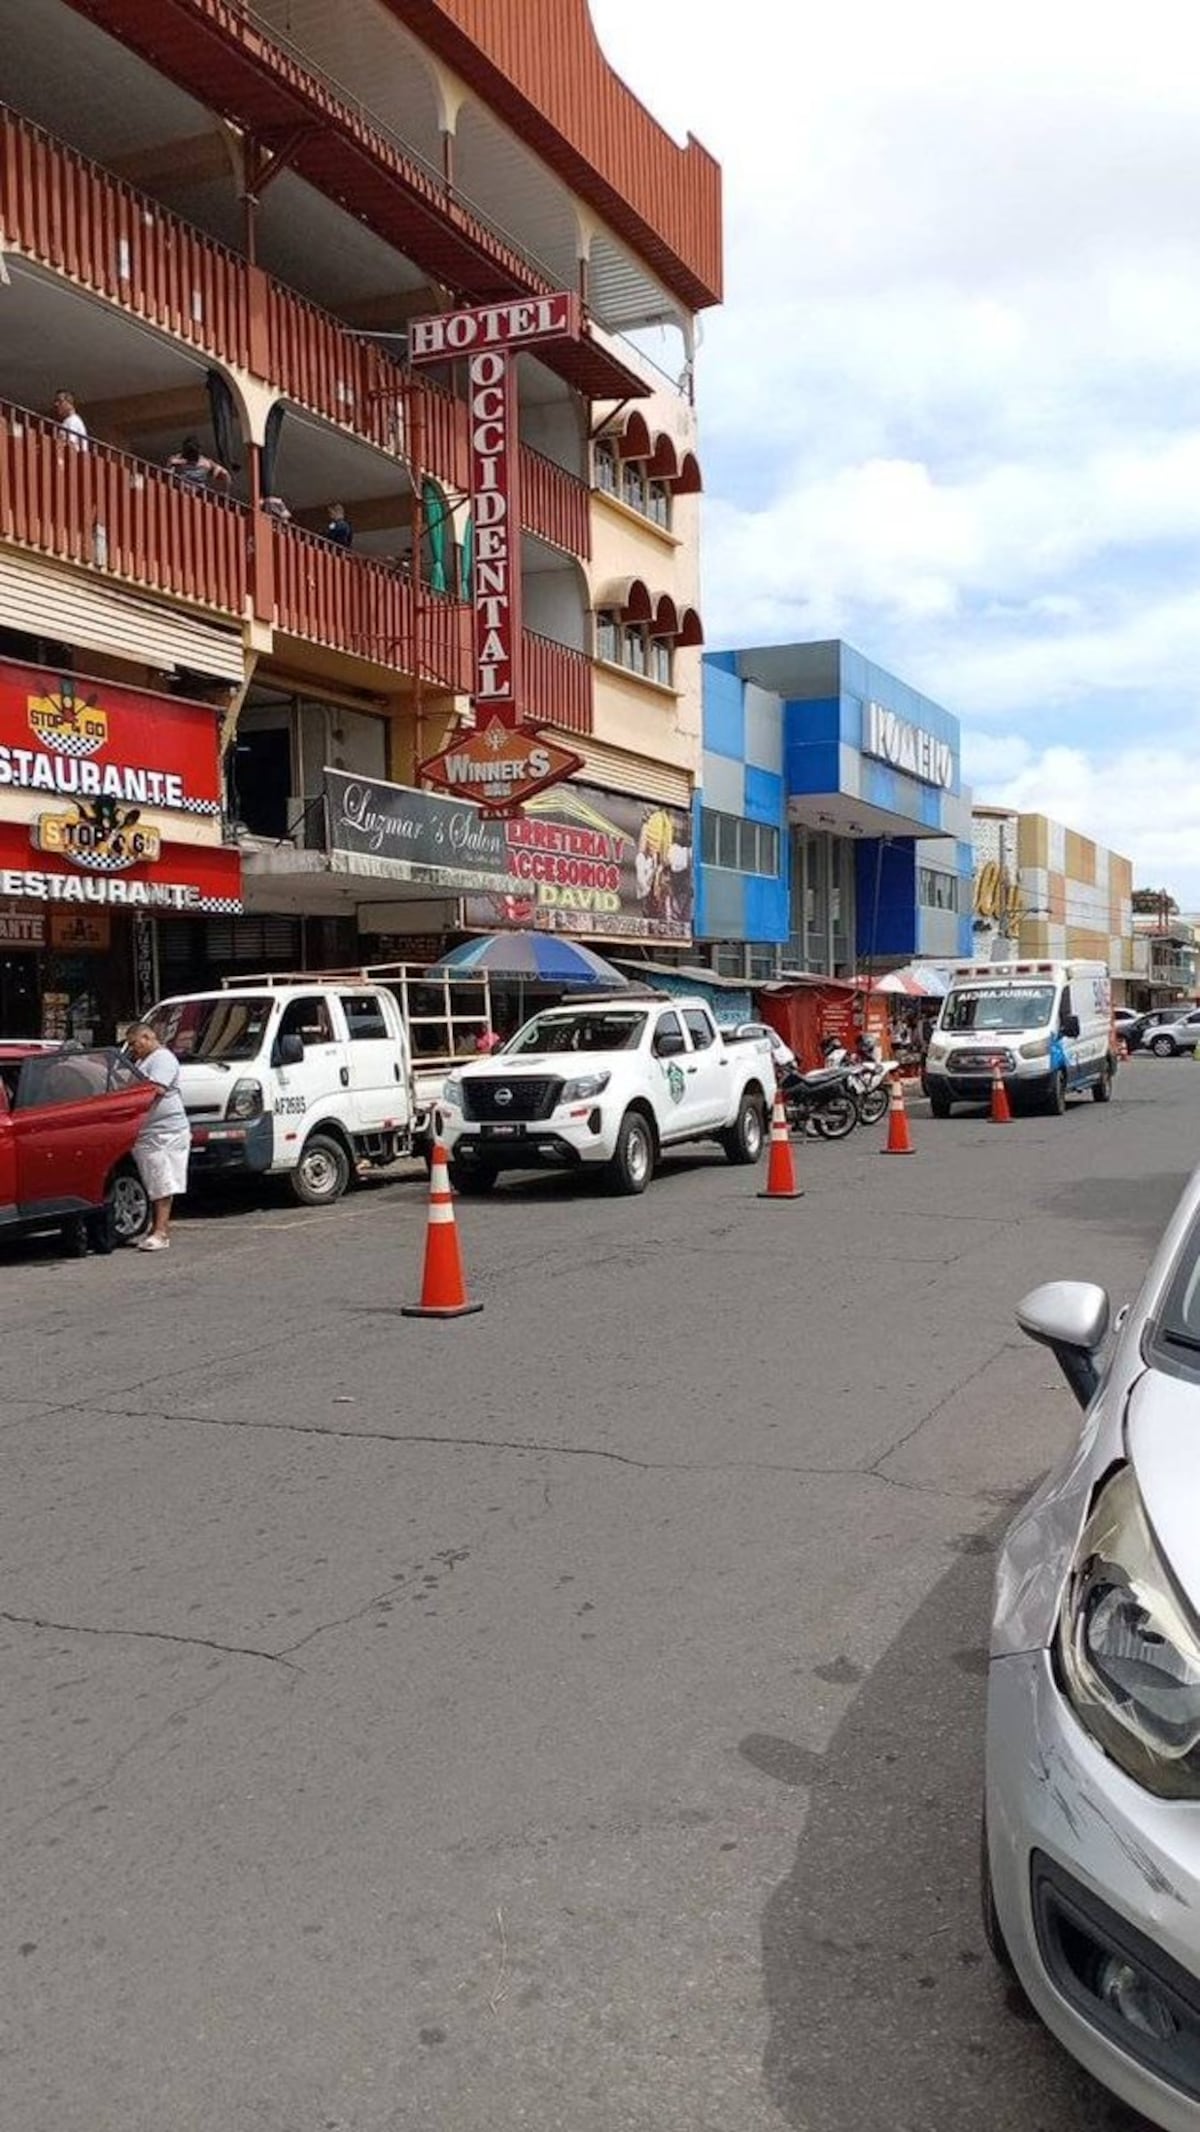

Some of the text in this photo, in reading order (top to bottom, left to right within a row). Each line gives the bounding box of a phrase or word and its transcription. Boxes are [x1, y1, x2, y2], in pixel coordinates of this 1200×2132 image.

[412, 300, 566, 354] HOTEL
[469, 352, 510, 698] OCCIDENTAL
[31, 711, 65, 729] STOP
[85, 720, 105, 737] GO
[870, 701, 951, 788] ROMERO
[46, 820, 105, 848] STOP
[538, 885, 622, 912] DAVID
